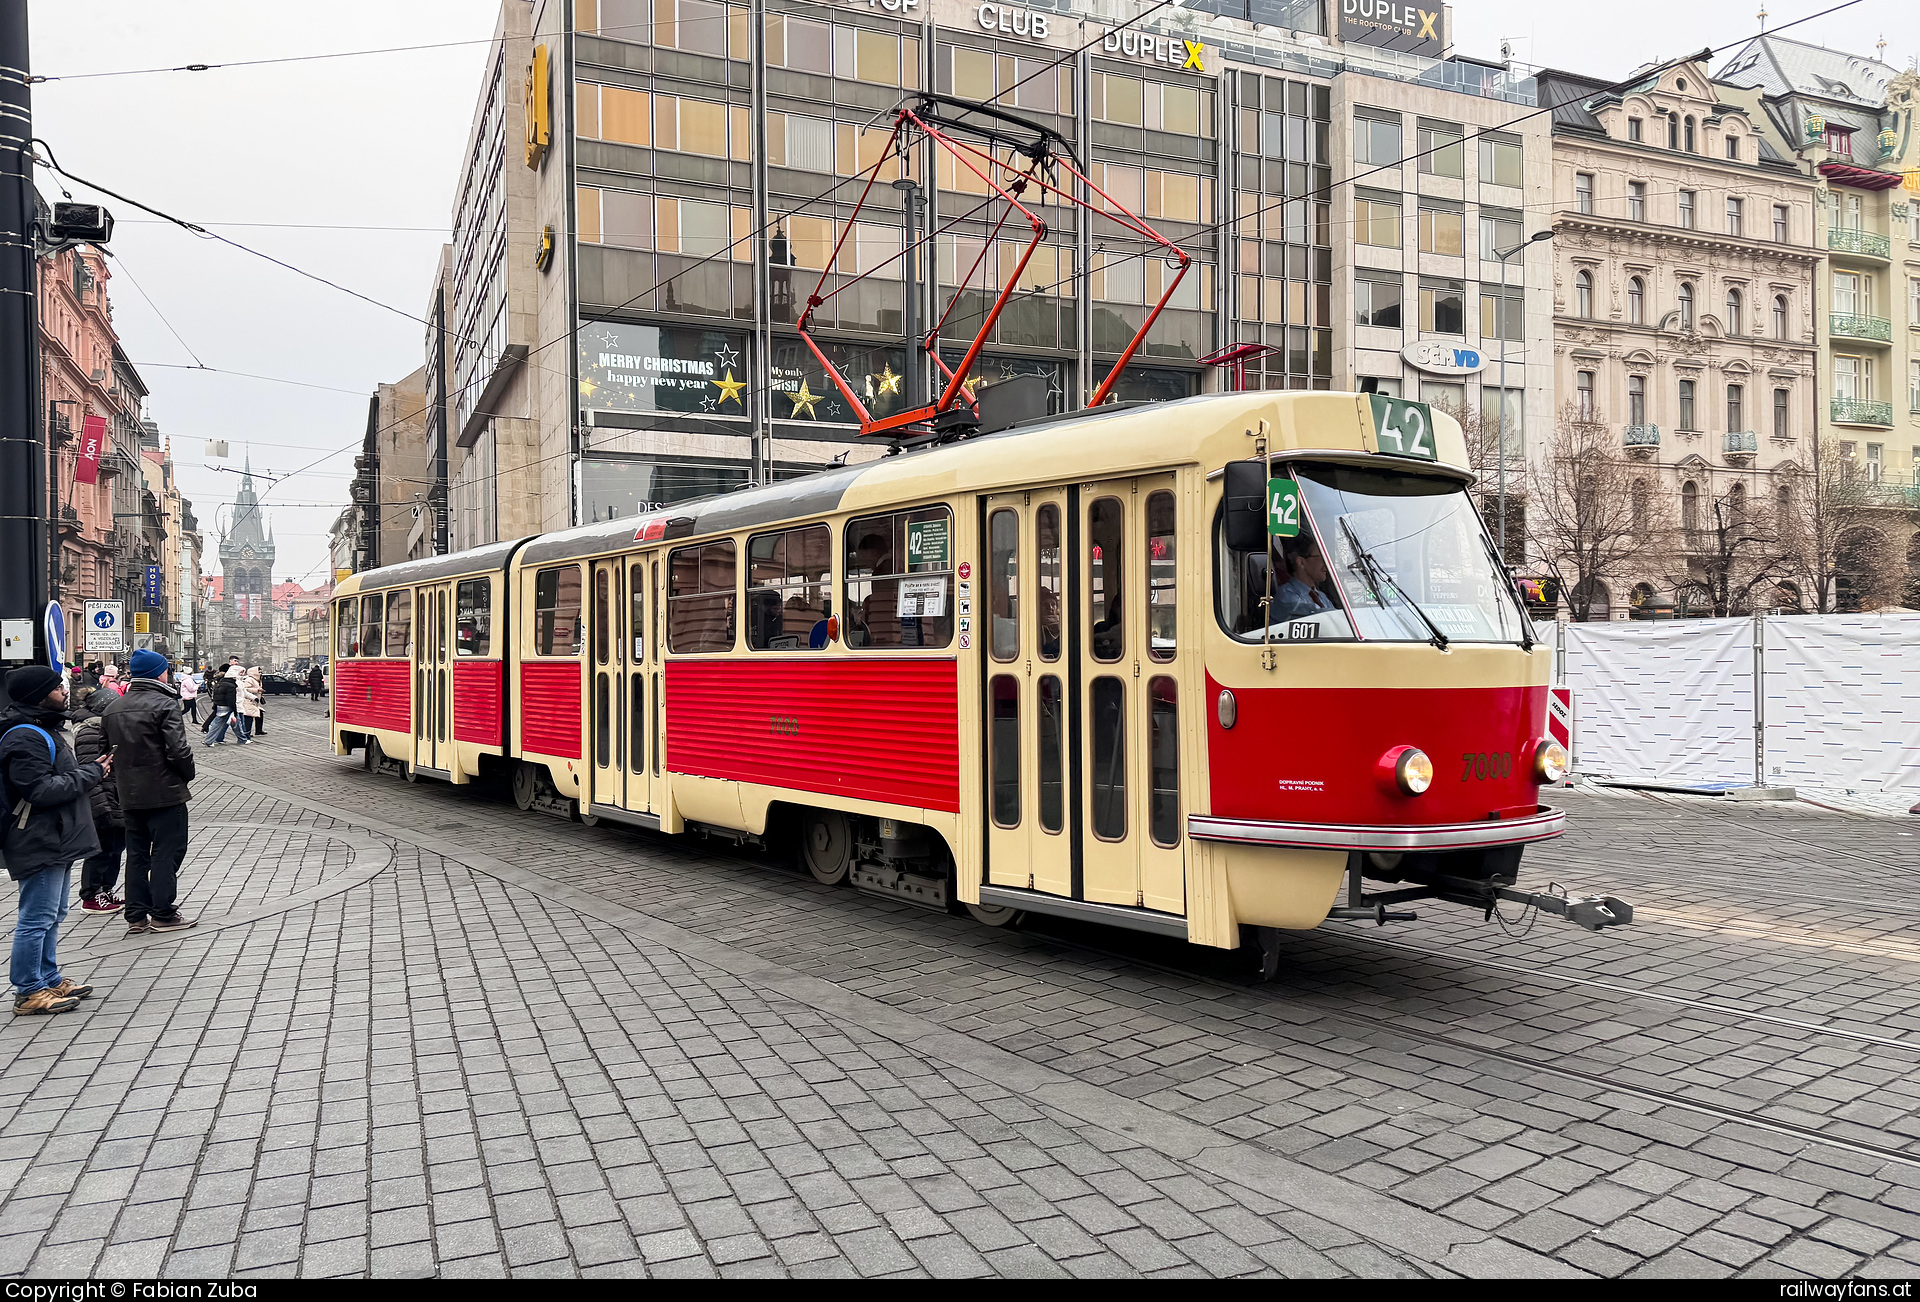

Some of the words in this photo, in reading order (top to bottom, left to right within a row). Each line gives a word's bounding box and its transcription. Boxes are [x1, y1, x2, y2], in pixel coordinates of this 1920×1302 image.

[978, 2, 1048, 39] CLUB
[1343, 0, 1438, 40] DUPLEX
[1344, 16, 1358, 25] THE
[1360, 19, 1393, 31] ROOFTOP
[1104, 26, 1205, 71] DUPLEX
[598, 352, 641, 370] MERRY
[643, 355, 714, 376] CHRISTMAS
[1417, 343, 1480, 368] SČMVD
[607, 370, 647, 388] happy
[650, 376, 677, 388] new
[678, 378, 708, 391] year
[771, 366, 784, 377] My
[785, 367, 804, 378] only
[771, 379, 798, 392] WISH
[1380, 402, 1431, 456] 42
[84, 438, 97, 461] AON
[637, 501, 666, 514] DES
[1270, 492, 1297, 525] 42
[909, 531, 922, 555] 42
[1292, 623, 1316, 639] 601
[770, 715, 799, 736] 7000
[1461, 752, 1512, 782] 7000
